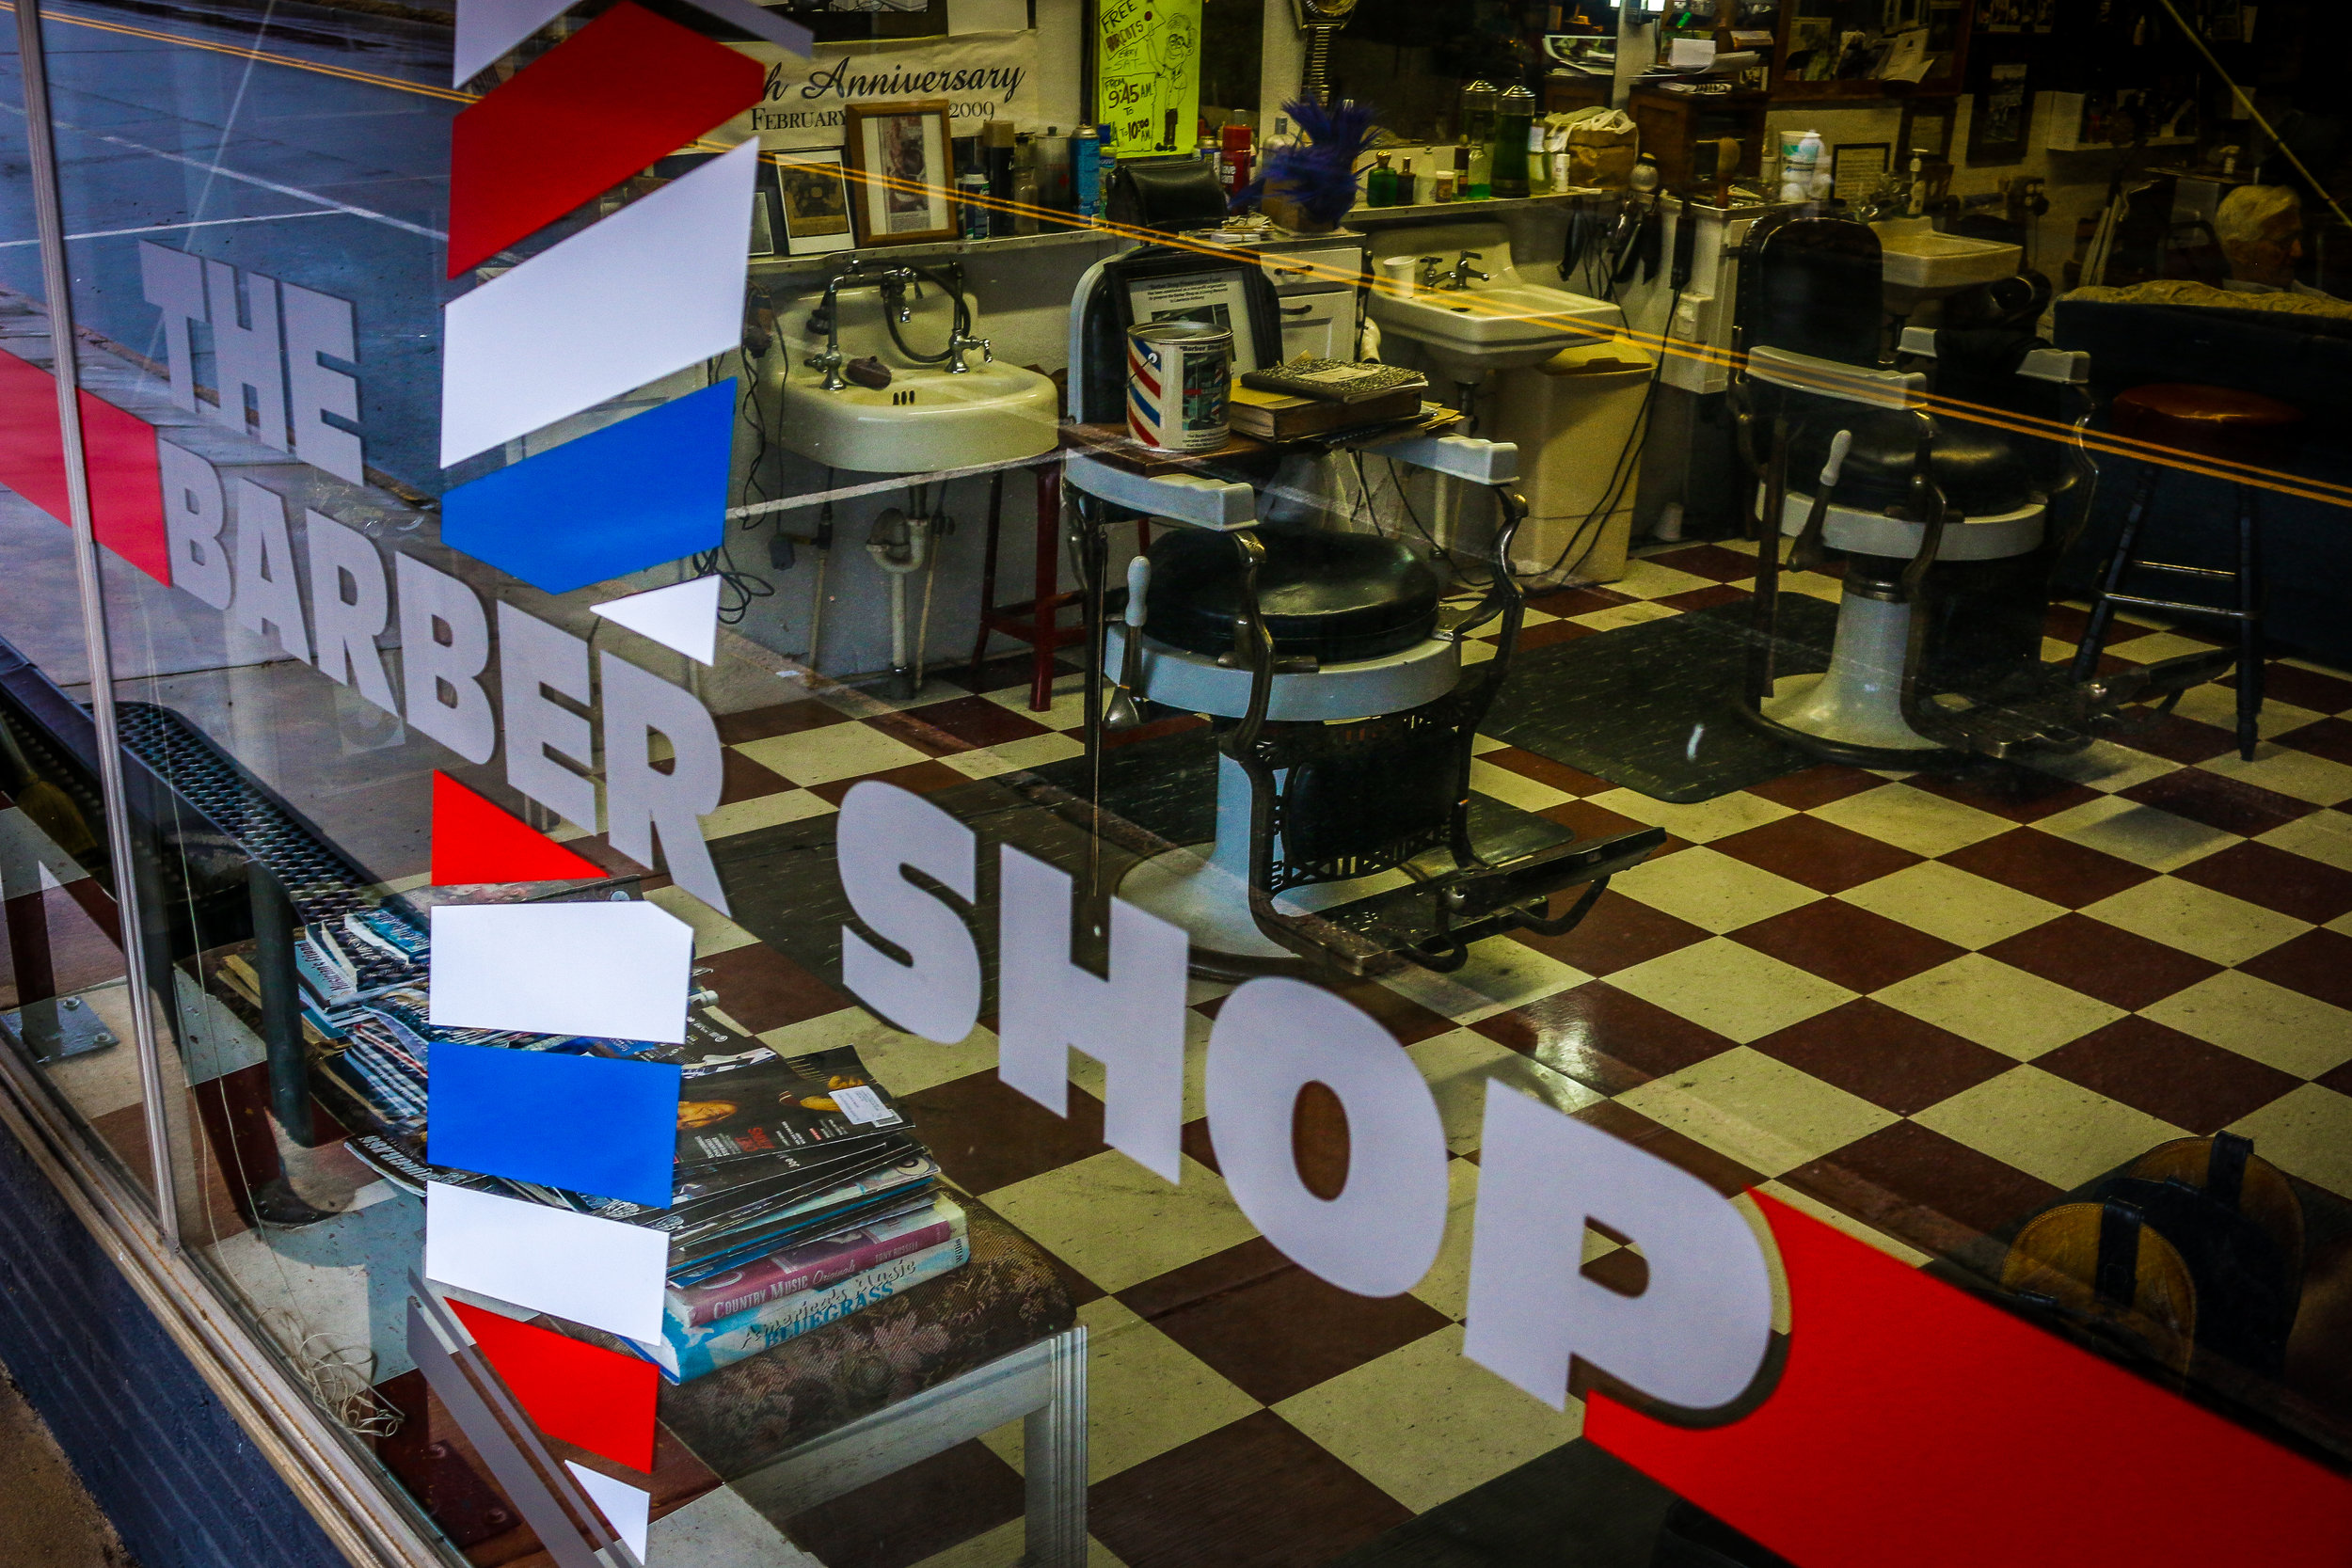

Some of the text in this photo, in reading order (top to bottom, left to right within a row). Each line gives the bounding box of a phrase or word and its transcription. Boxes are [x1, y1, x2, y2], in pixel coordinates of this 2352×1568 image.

[1101, 0, 1137, 34] FREE
[800, 55, 1027, 103] Anniversary
[752, 101, 994, 132] FEBRUARY 2009
[138, 239, 364, 487] THE
[158, 437, 1772, 1412] BARBER SHOP
[714, 1291, 766, 1319] COUNTRY
[770, 1275, 808, 1300] MUSIC
[855, 1259, 916, 1301] Music
[764, 1280, 894, 1349] BLUEGRASS
